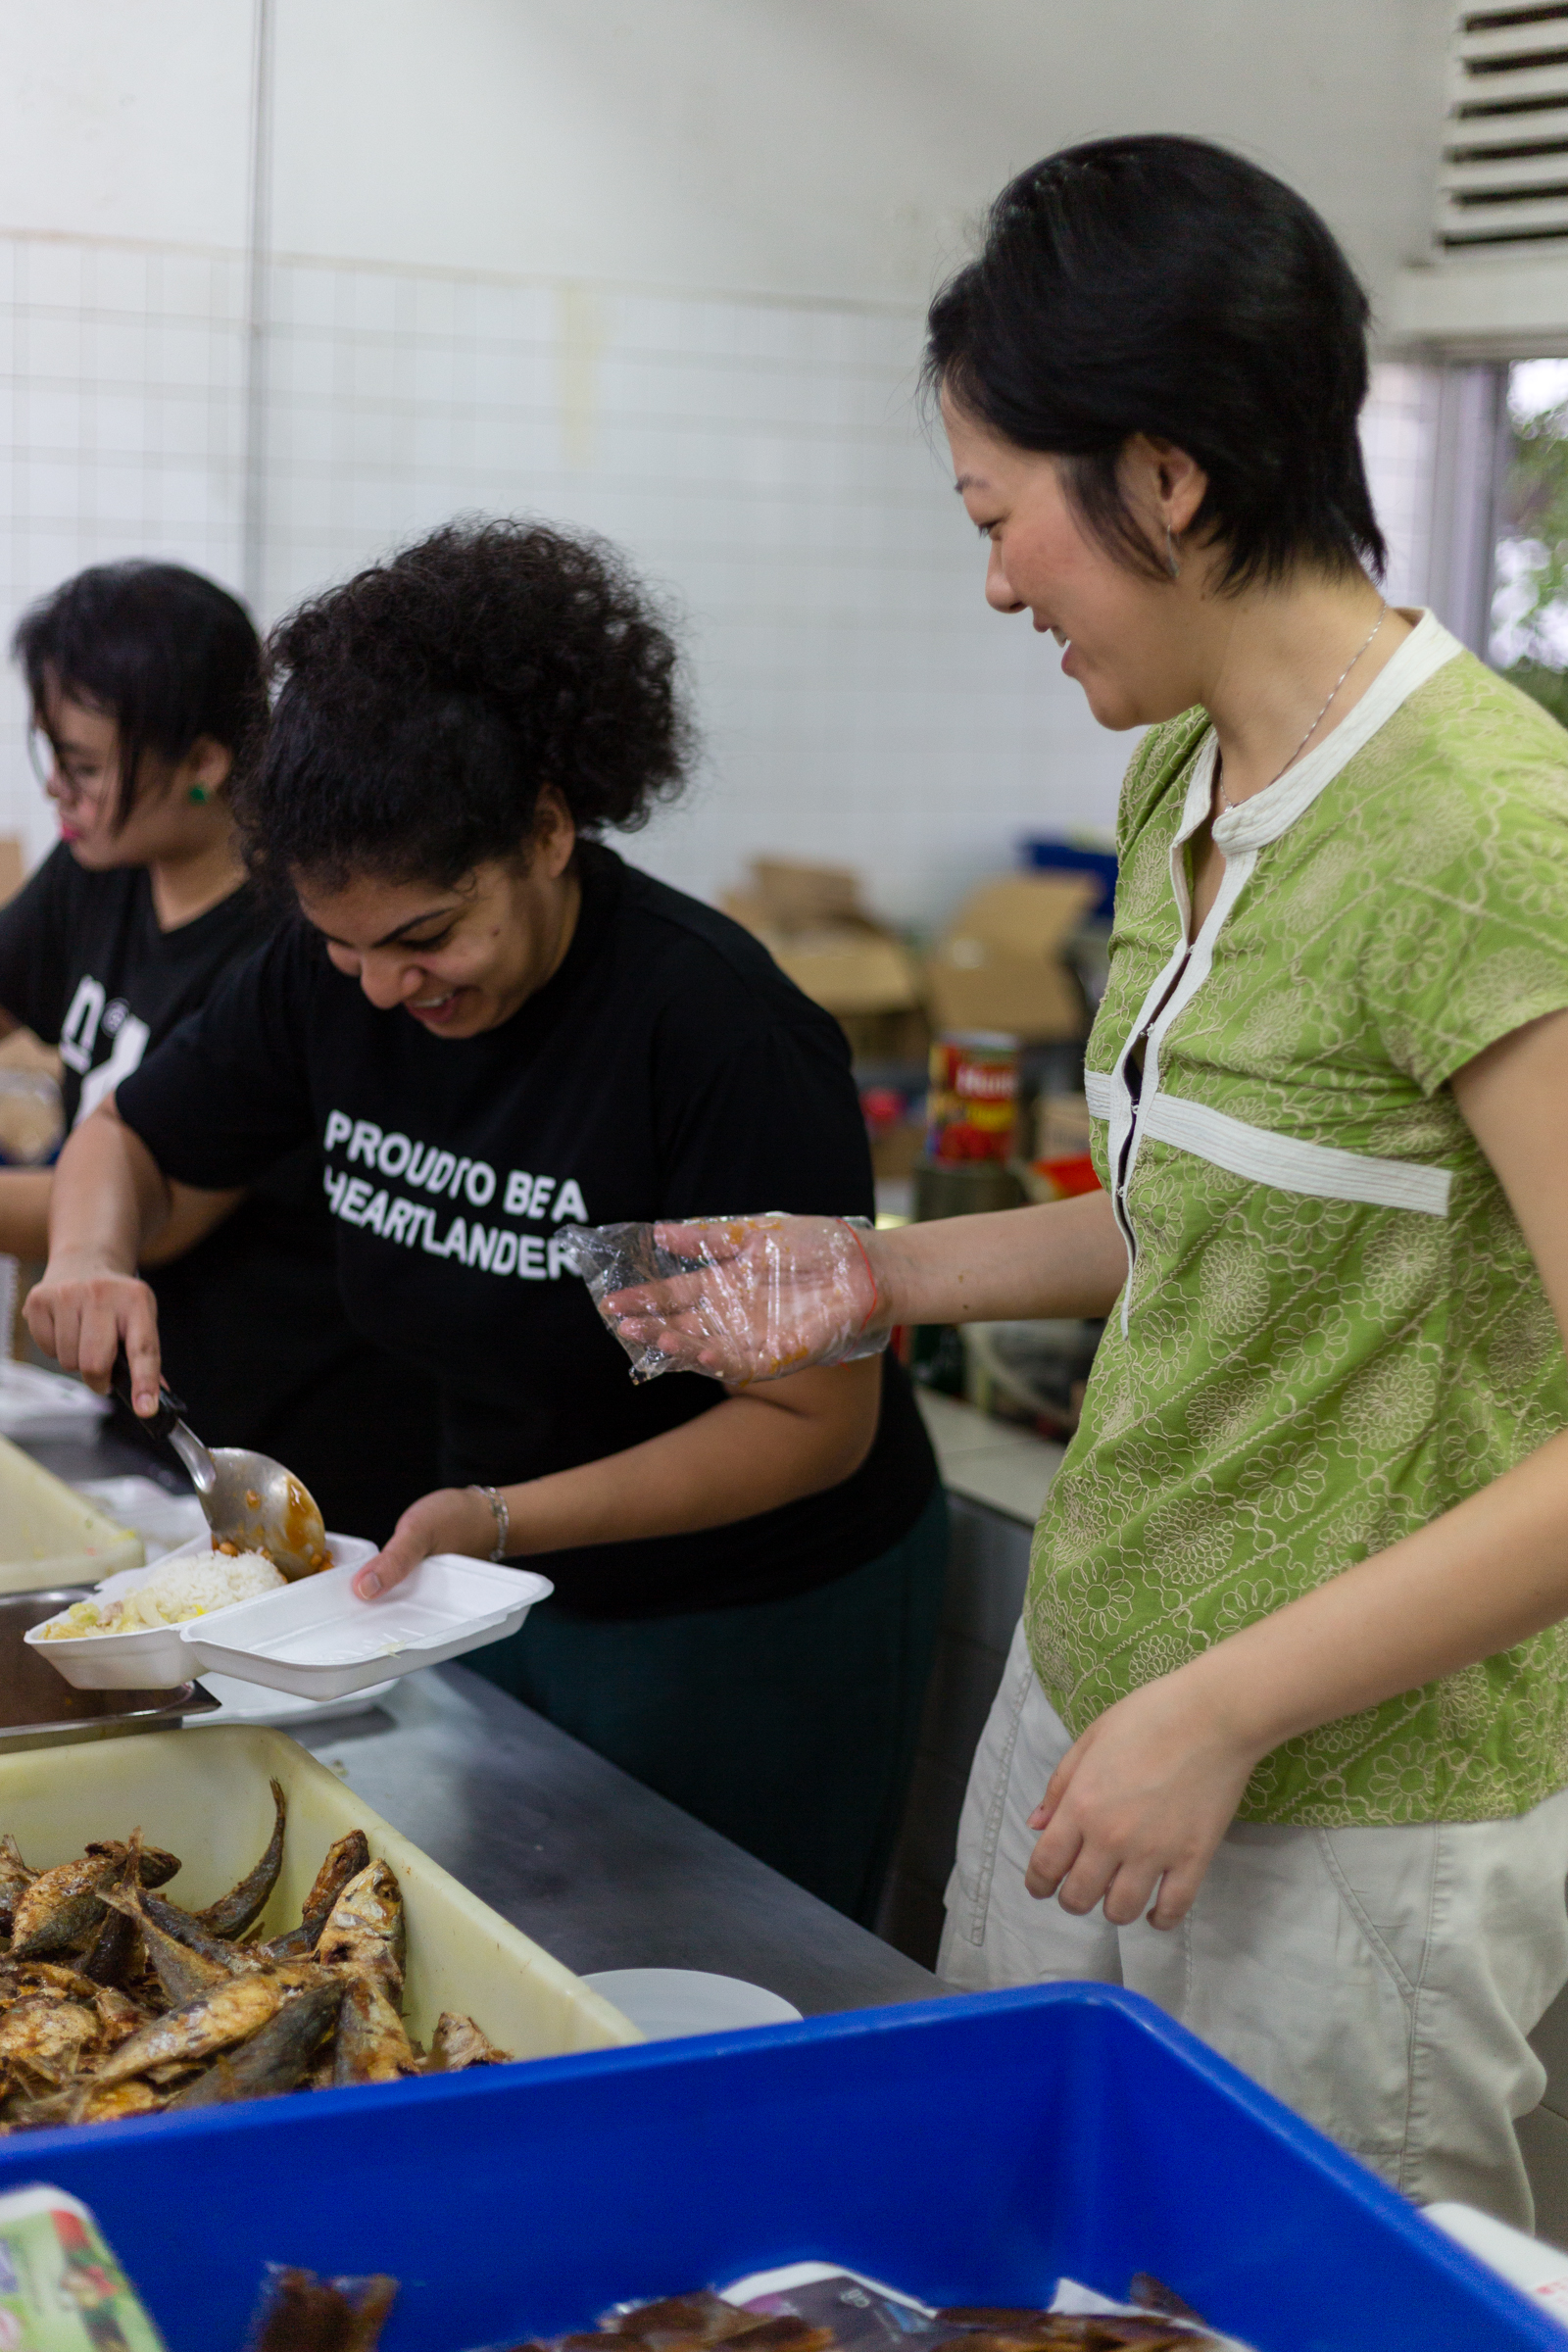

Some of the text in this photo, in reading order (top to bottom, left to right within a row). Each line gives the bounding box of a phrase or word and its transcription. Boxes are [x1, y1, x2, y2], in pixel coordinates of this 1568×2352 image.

[323, 1164, 584, 1280] HEARTLANDER
[324, 1109, 458, 1194] PROUD
[503, 1169, 556, 1219] BE
[551, 1179, 588, 1223] A
